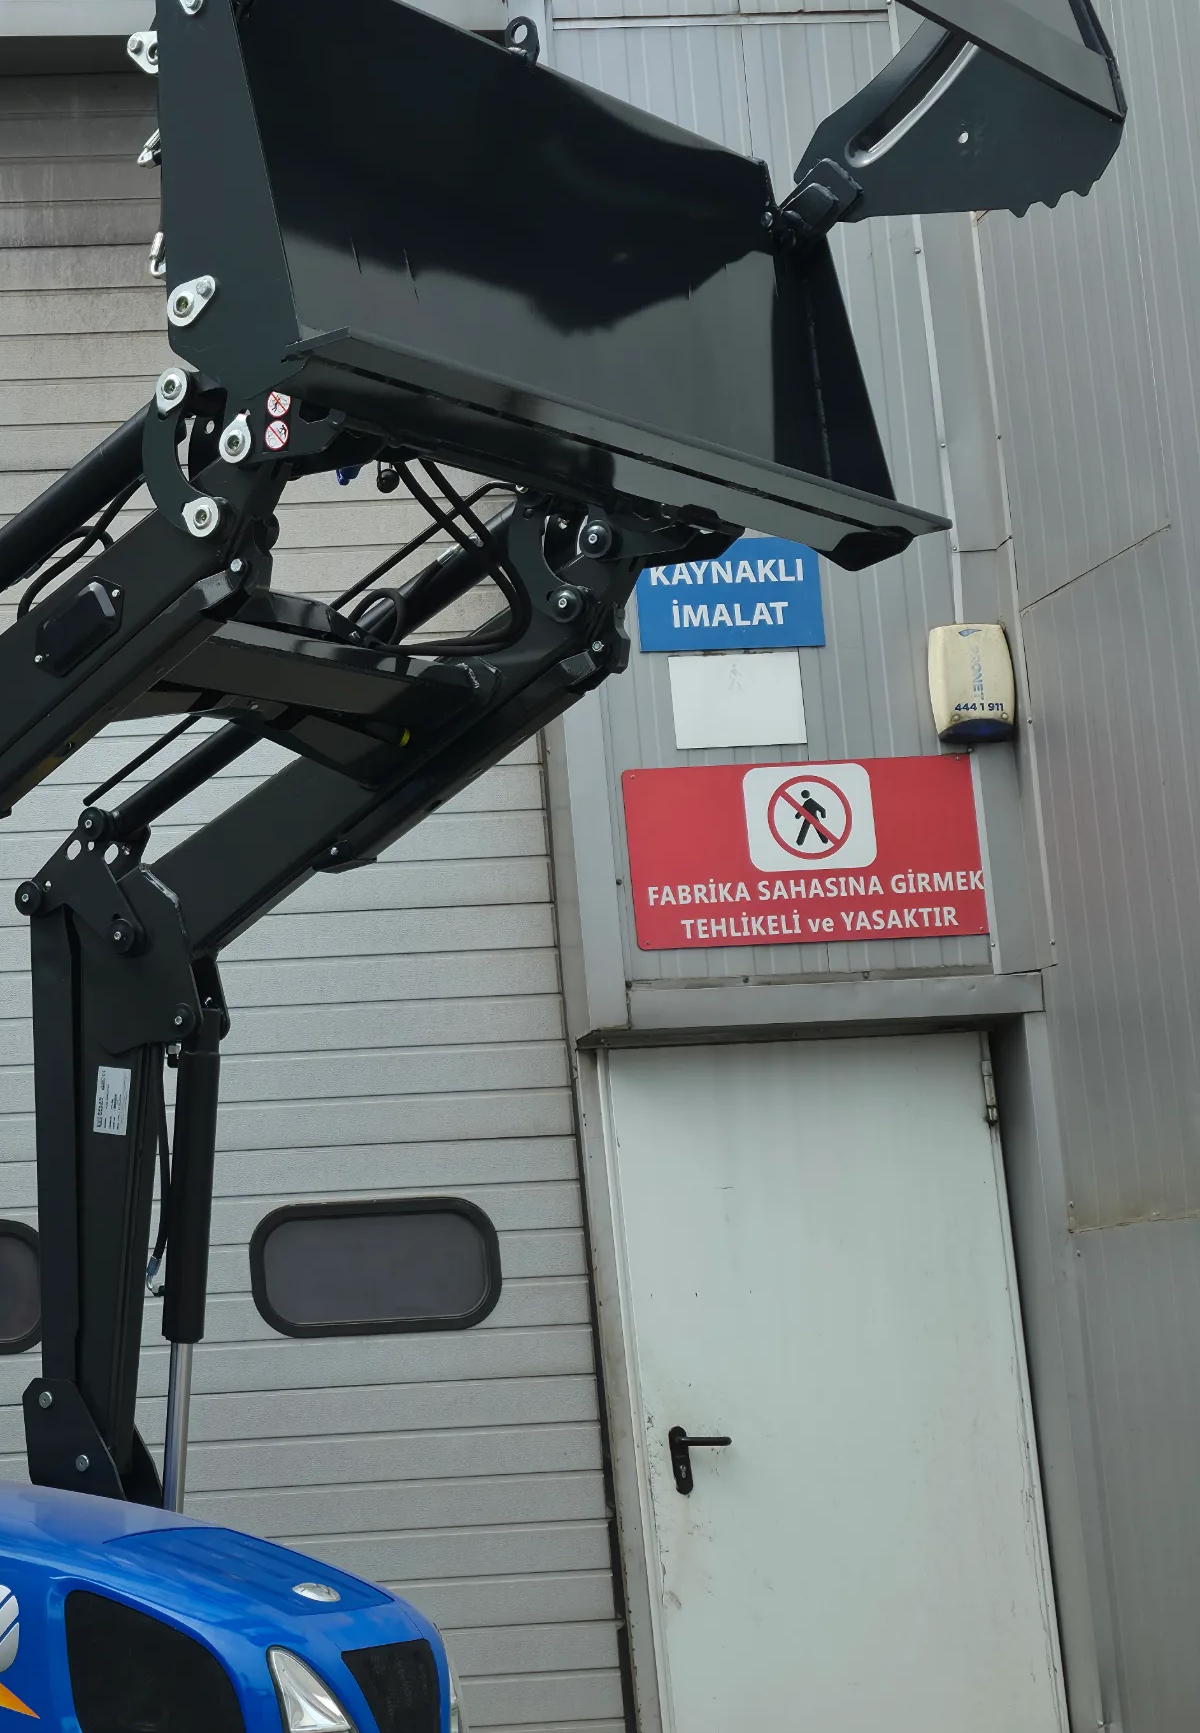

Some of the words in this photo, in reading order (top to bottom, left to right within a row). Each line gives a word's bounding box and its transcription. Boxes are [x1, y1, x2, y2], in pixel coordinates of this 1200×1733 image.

[650, 558, 804, 586] KAYNAKLI
[672, 599, 789, 628] İMALAT
[954, 702, 978, 711] 444
[980, 702, 985, 711] 1
[987, 702, 1004, 711] 911
[648, 878, 751, 906] FABRİKA
[758, 876, 885, 901] SAHASINA
[890, 869, 985, 894] GİRMEK
[681, 909, 802, 939] TEHLİKELİ
[807, 917, 835, 933] ve
[840, 906, 960, 931] YASAKTIR
